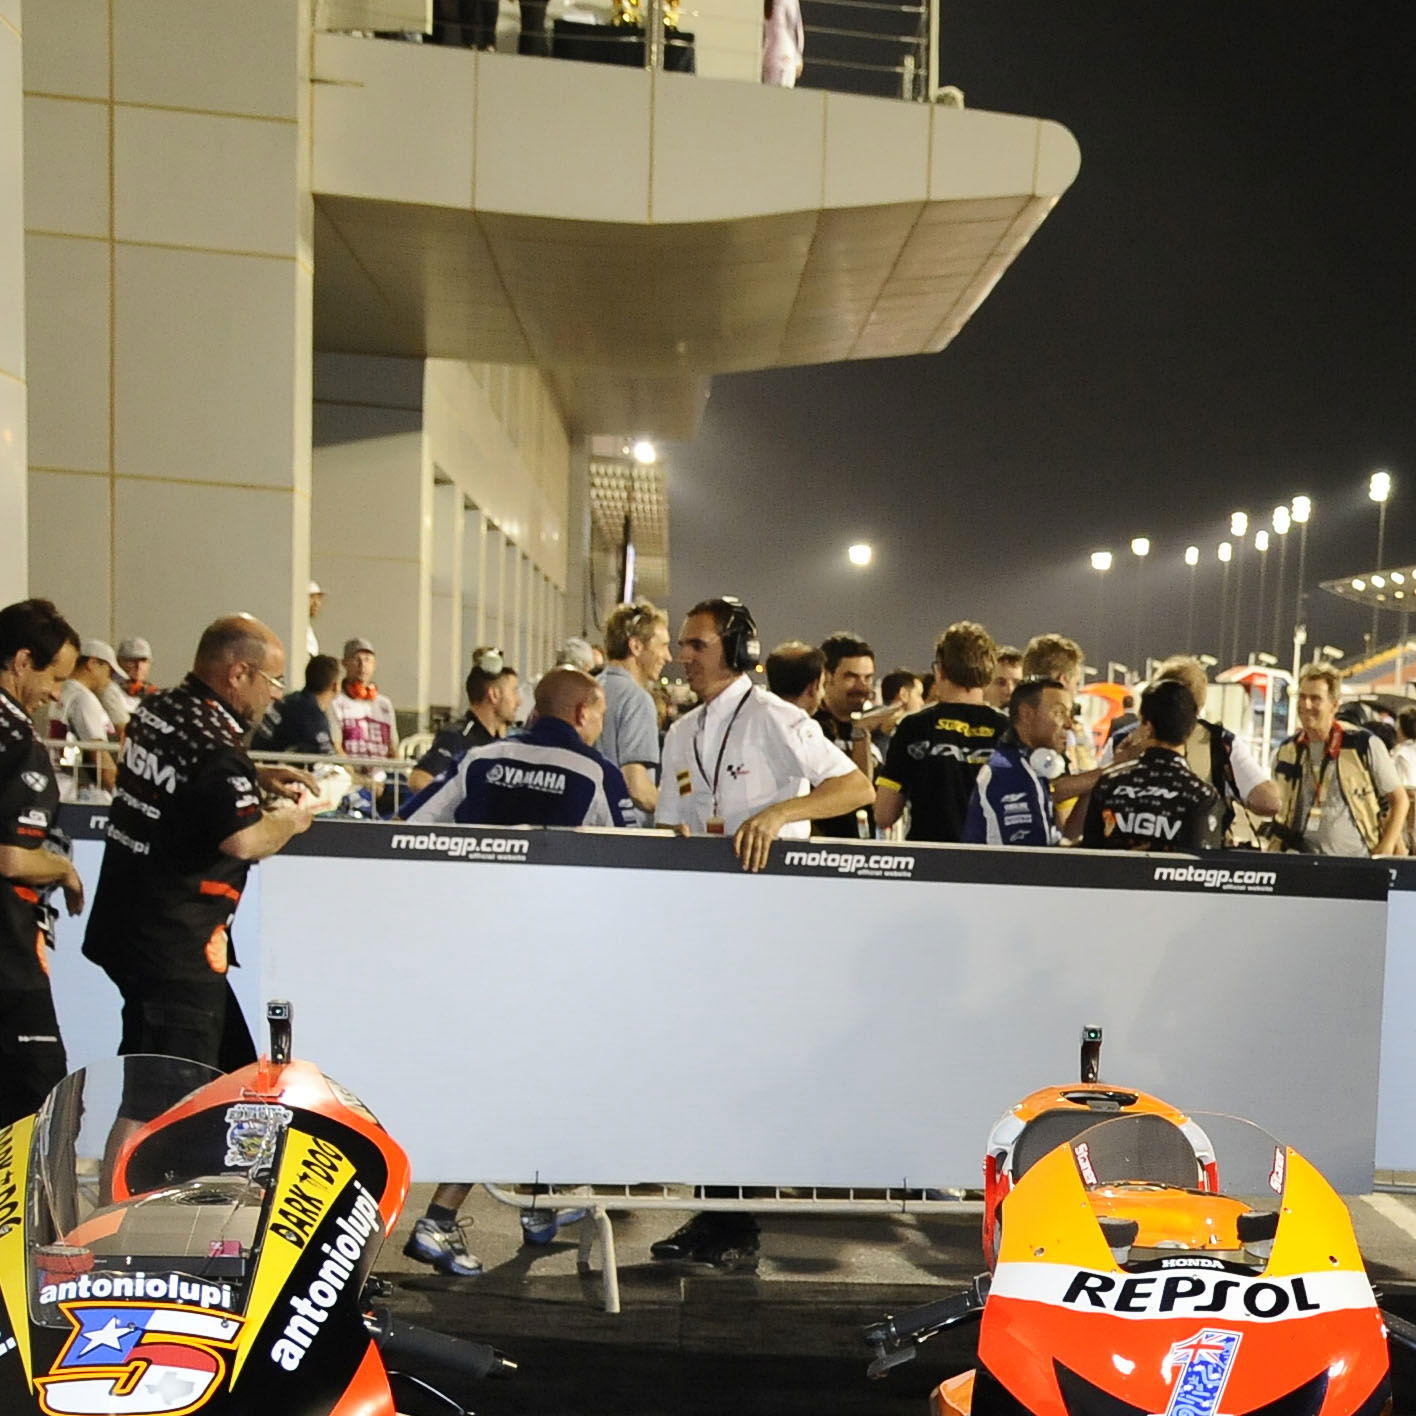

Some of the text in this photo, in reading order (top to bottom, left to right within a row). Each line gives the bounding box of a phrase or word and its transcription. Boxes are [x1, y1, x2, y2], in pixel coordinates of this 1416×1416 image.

[503, 767, 566, 791] YAMAHA
[391, 832, 529, 856] motogp.com
[785, 849, 915, 872] motogp.com
[1153, 865, 1277, 887] motogp.com
[269, 1135, 344, 1250] DARK DOG
[270, 1179, 380, 1372] antoniolupi
[1161, 1257, 1226, 1270] HONDA
[39, 1271, 231, 1309] antoniolupi
[1062, 1270, 1323, 1320] REPSOL
